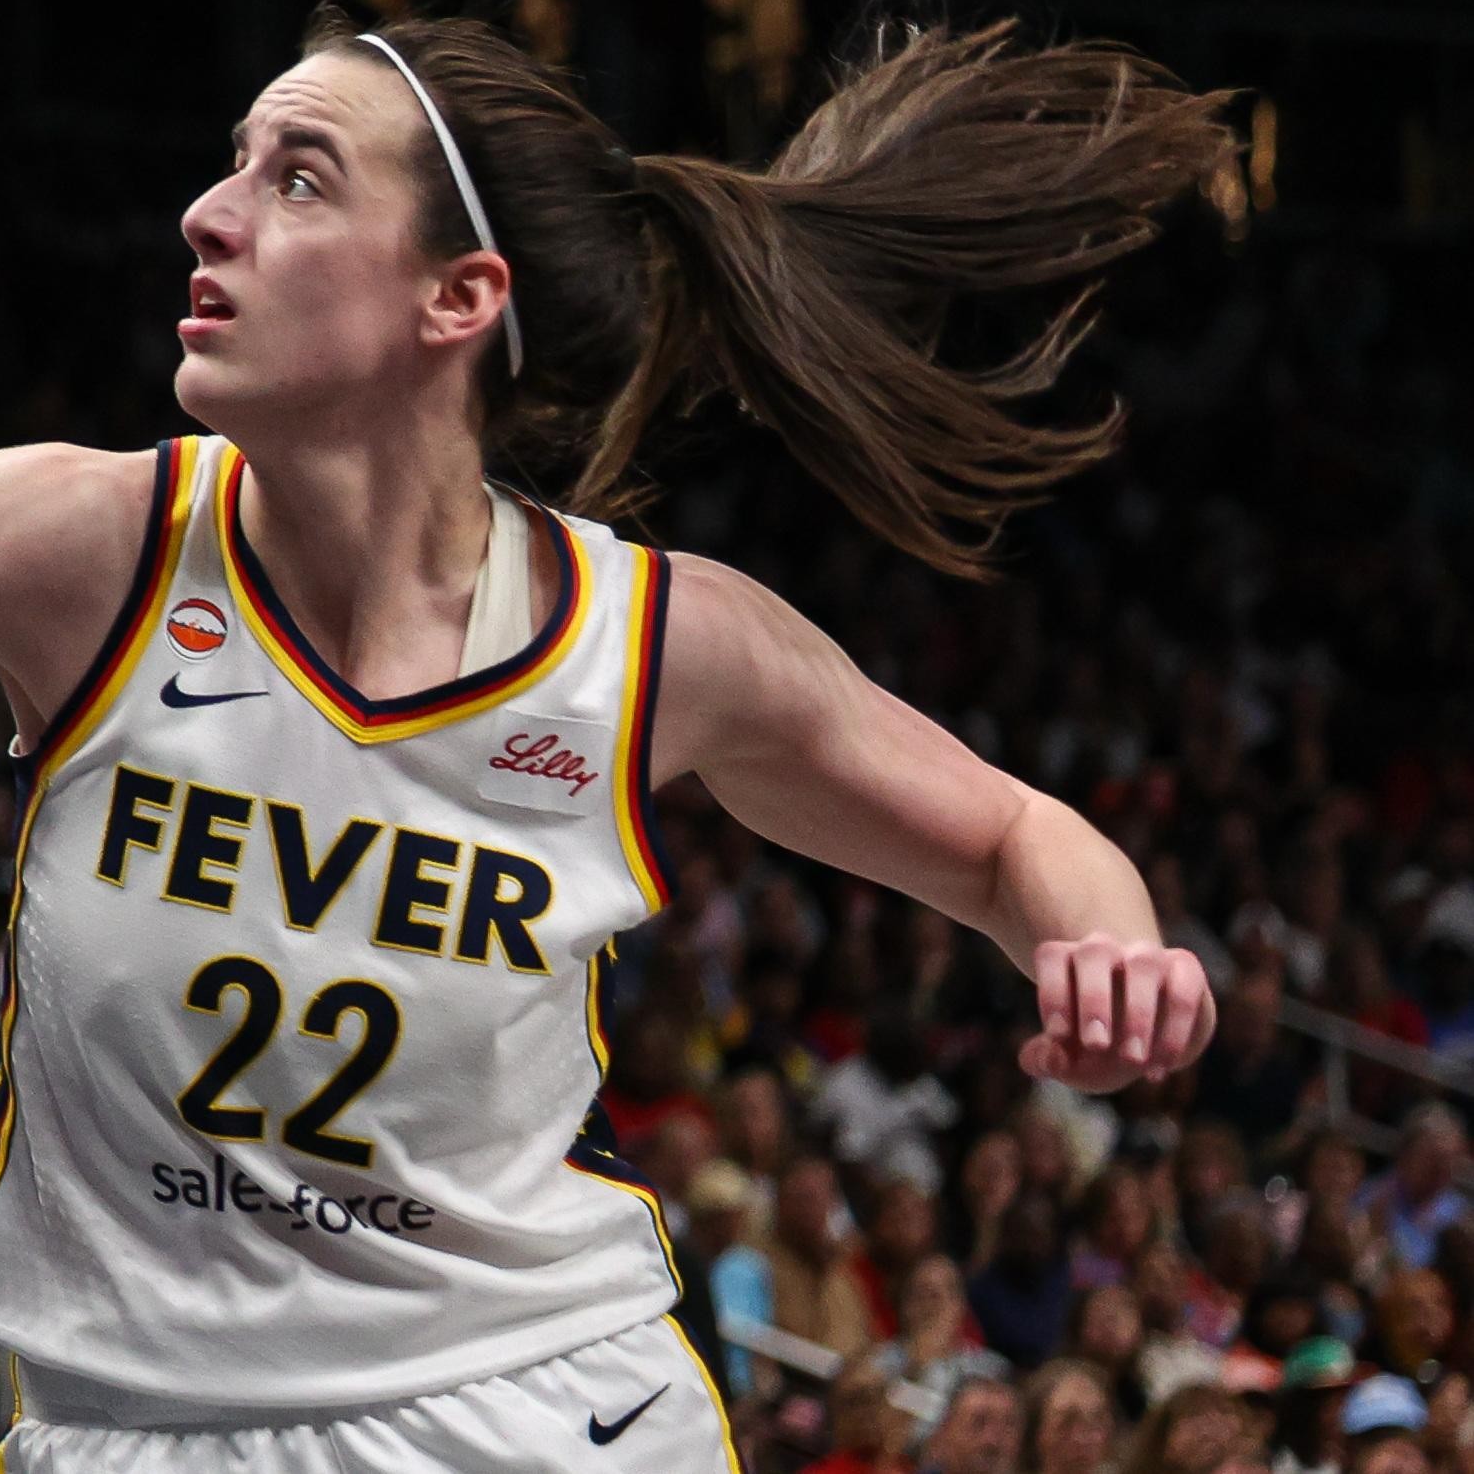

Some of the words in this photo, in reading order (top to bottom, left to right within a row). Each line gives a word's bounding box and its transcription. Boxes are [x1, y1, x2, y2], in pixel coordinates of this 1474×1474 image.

[489, 733, 599, 797] Lilly
[96, 762, 552, 975] FEVER
[176, 954, 403, 1169] 22
[152, 1154, 436, 1235] saleforce
